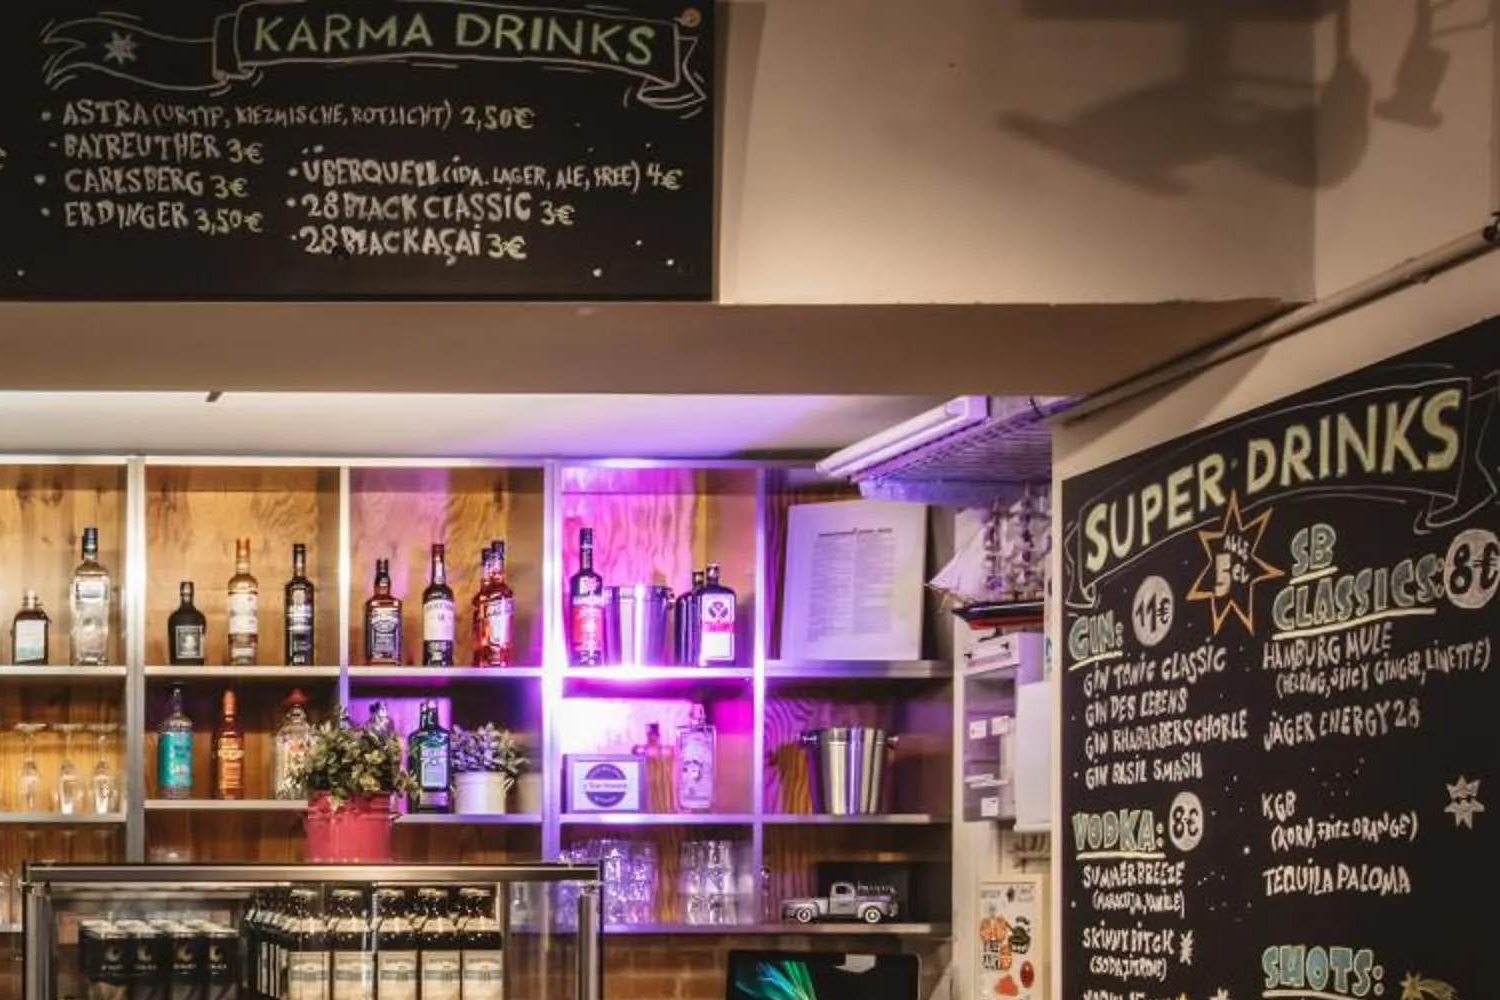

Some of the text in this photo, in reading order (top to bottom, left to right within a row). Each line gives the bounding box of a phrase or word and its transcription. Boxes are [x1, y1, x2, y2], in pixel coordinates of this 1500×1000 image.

[253, 12, 657, 66] KARMA DRINKS
[62, 99, 149, 127] ASTRA
[459, 105, 536, 132] 2,50€
[63, 131, 264, 165] BAYREUTHER 3€
[64, 166, 249, 199] CARLSBERG 3€
[646, 162, 683, 190] 4€
[64, 200, 265, 235] ERDINGER 3,50€
[301, 187, 576, 226] 28 BLACK CLASSIC 3€
[299, 223, 340, 254] 28
[486, 233, 528, 260] 3€
[1085, 387, 1464, 573] SUPER DRINKS
[1290, 522, 1337, 577] SB
[1262, 621, 1394, 671] HAMBURG MULE
[1083, 637, 1227, 698] GIN TONIC CLASSIC
[1085, 694, 1107, 728] GIN
[1111, 695, 1137, 722] DES
[1263, 711, 1316, 752] JÄGER
[1319, 700, 1391, 737] ENERGY
[1085, 731, 1108, 762] GIN
[1085, 759, 1109, 790] GIN
[1153, 751, 1204, 783] SMASH
[1171, 804, 1200, 841] 8€
[1261, 789, 1297, 823] KGB
[1352, 810, 1419, 843] ORANGE)
[1261, 857, 1412, 897] TEQUILA PALOMA
